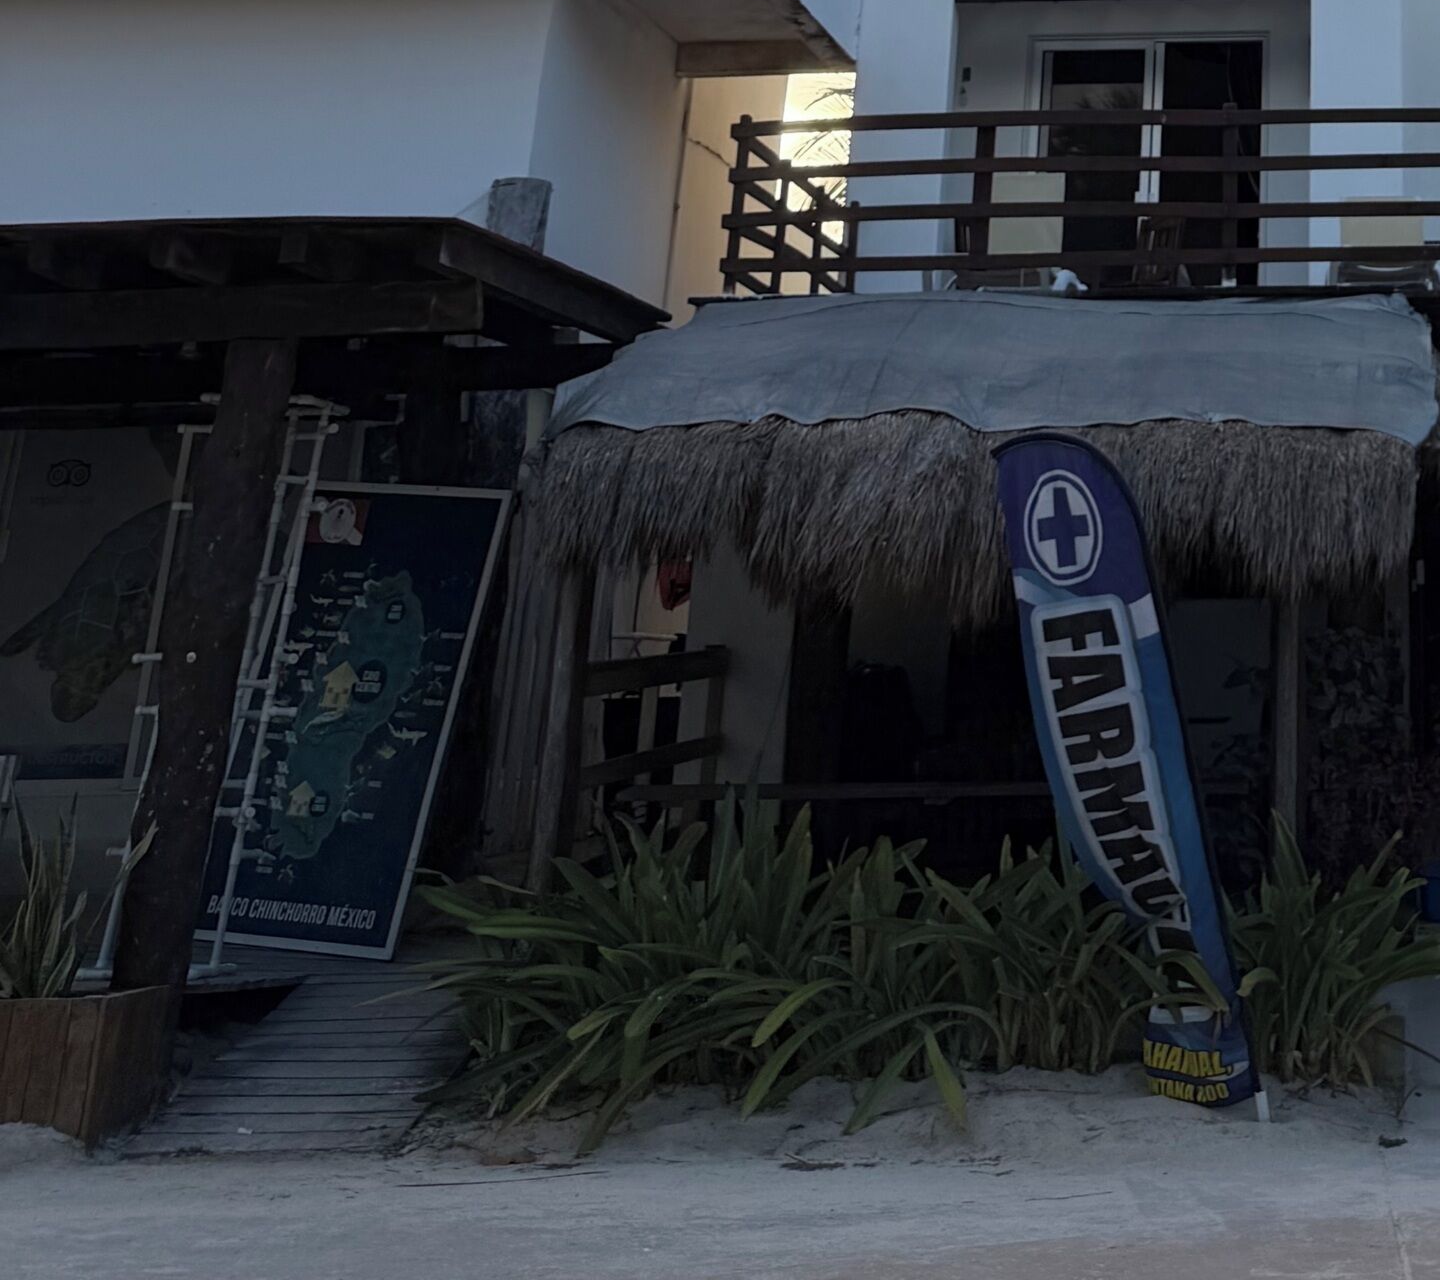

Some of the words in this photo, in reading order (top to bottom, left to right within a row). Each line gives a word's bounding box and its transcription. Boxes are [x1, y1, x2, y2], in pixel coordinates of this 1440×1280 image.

[206, 894, 250, 917] BACO
[248, 899, 325, 925] CHINCHORRO
[326, 904, 376, 930] MÉXICO
